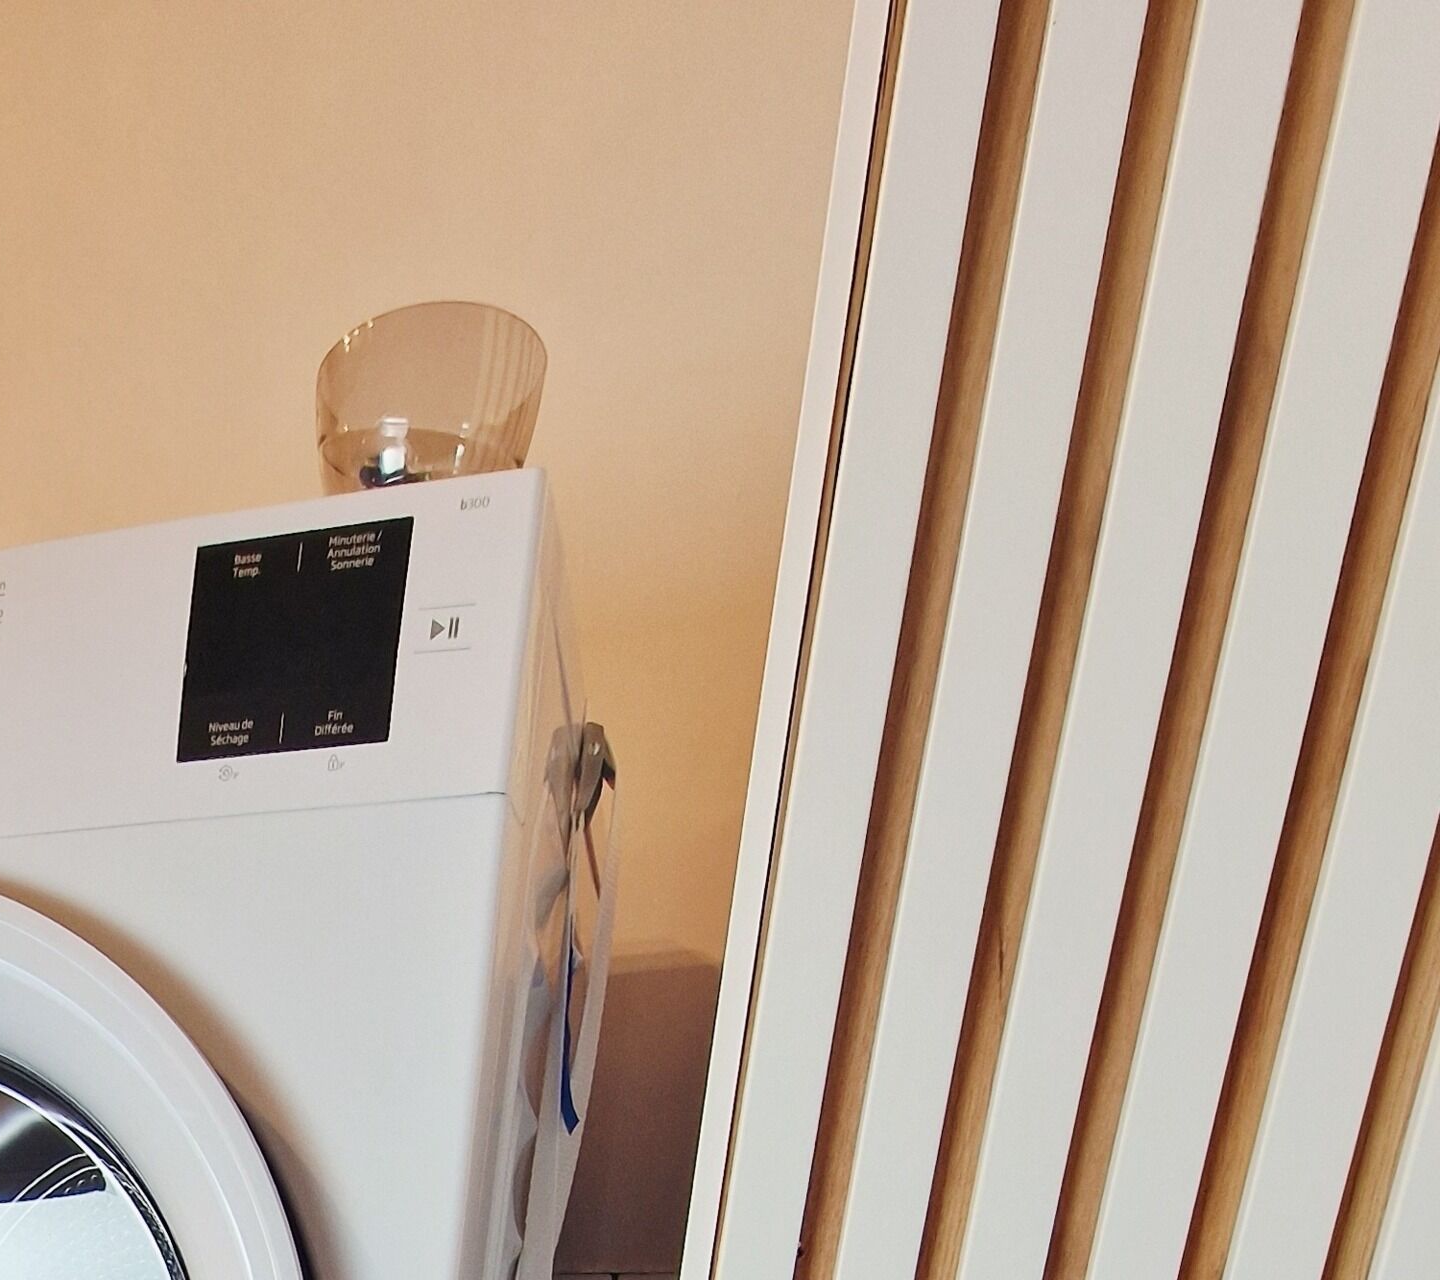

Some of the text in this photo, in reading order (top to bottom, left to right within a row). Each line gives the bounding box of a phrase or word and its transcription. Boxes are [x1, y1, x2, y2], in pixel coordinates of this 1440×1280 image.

[329, 531, 375, 547] Minuterie
[327, 544, 381, 559] Annulation
[234, 553, 262, 565] Basse
[330, 556, 374, 571] Sonnerie
[327, 709, 343, 721] Fin
[208, 718, 254, 733] Niveau de
[315, 722, 354, 736] Différée
[210, 733, 249, 746] Séchage
